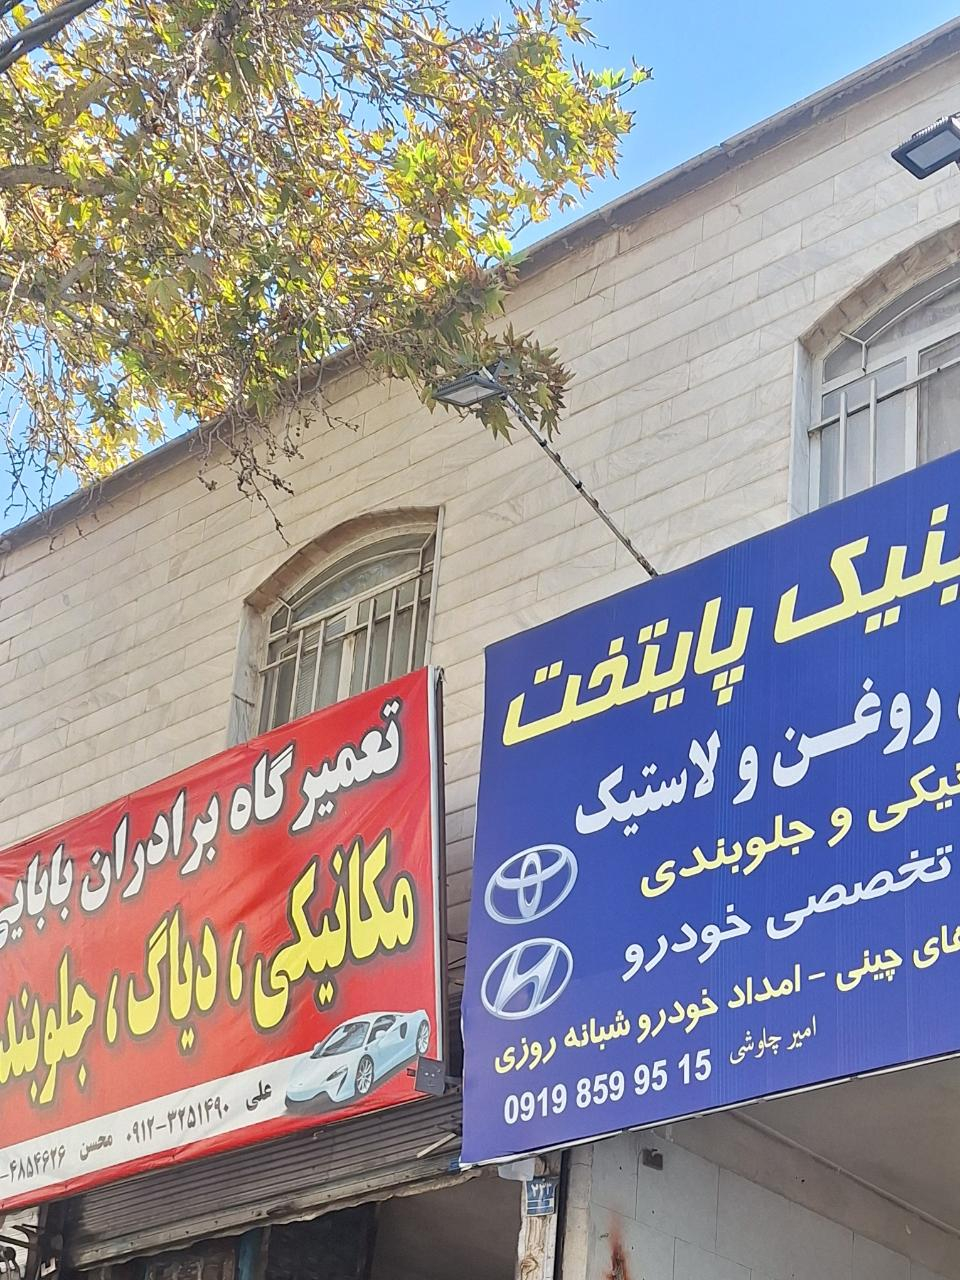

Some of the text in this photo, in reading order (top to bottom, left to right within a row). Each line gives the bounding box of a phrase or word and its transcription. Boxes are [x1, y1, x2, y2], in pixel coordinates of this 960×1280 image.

[502, 596, 754, 746] پایتخت
[772, 677, 942, 787] روغن
[574, 730, 722, 838] لاستیک
[732, 743, 759, 804] و
[80, 790, 219, 911] برادران
[826, 806, 853, 846] و
[639, 814, 815, 898] جلوبندی
[765, 842, 954, 940] تخصصی
[621, 903, 752, 981] خودرو
[834, 948, 903, 992] چینی
[727, 963, 801, 1008] امداد
[563, 1010, 631, 1049] شبانه
[636, 990, 719, 1043] خودرو
[786, 1014, 817, 1050] امیر
[494, 1035, 557, 1074] روزی
[246, 1080, 272, 1111] علی
[503, 1048, 713, 1124] 0919 859 95 15
[80, 1135, 113, 1161] محسن
